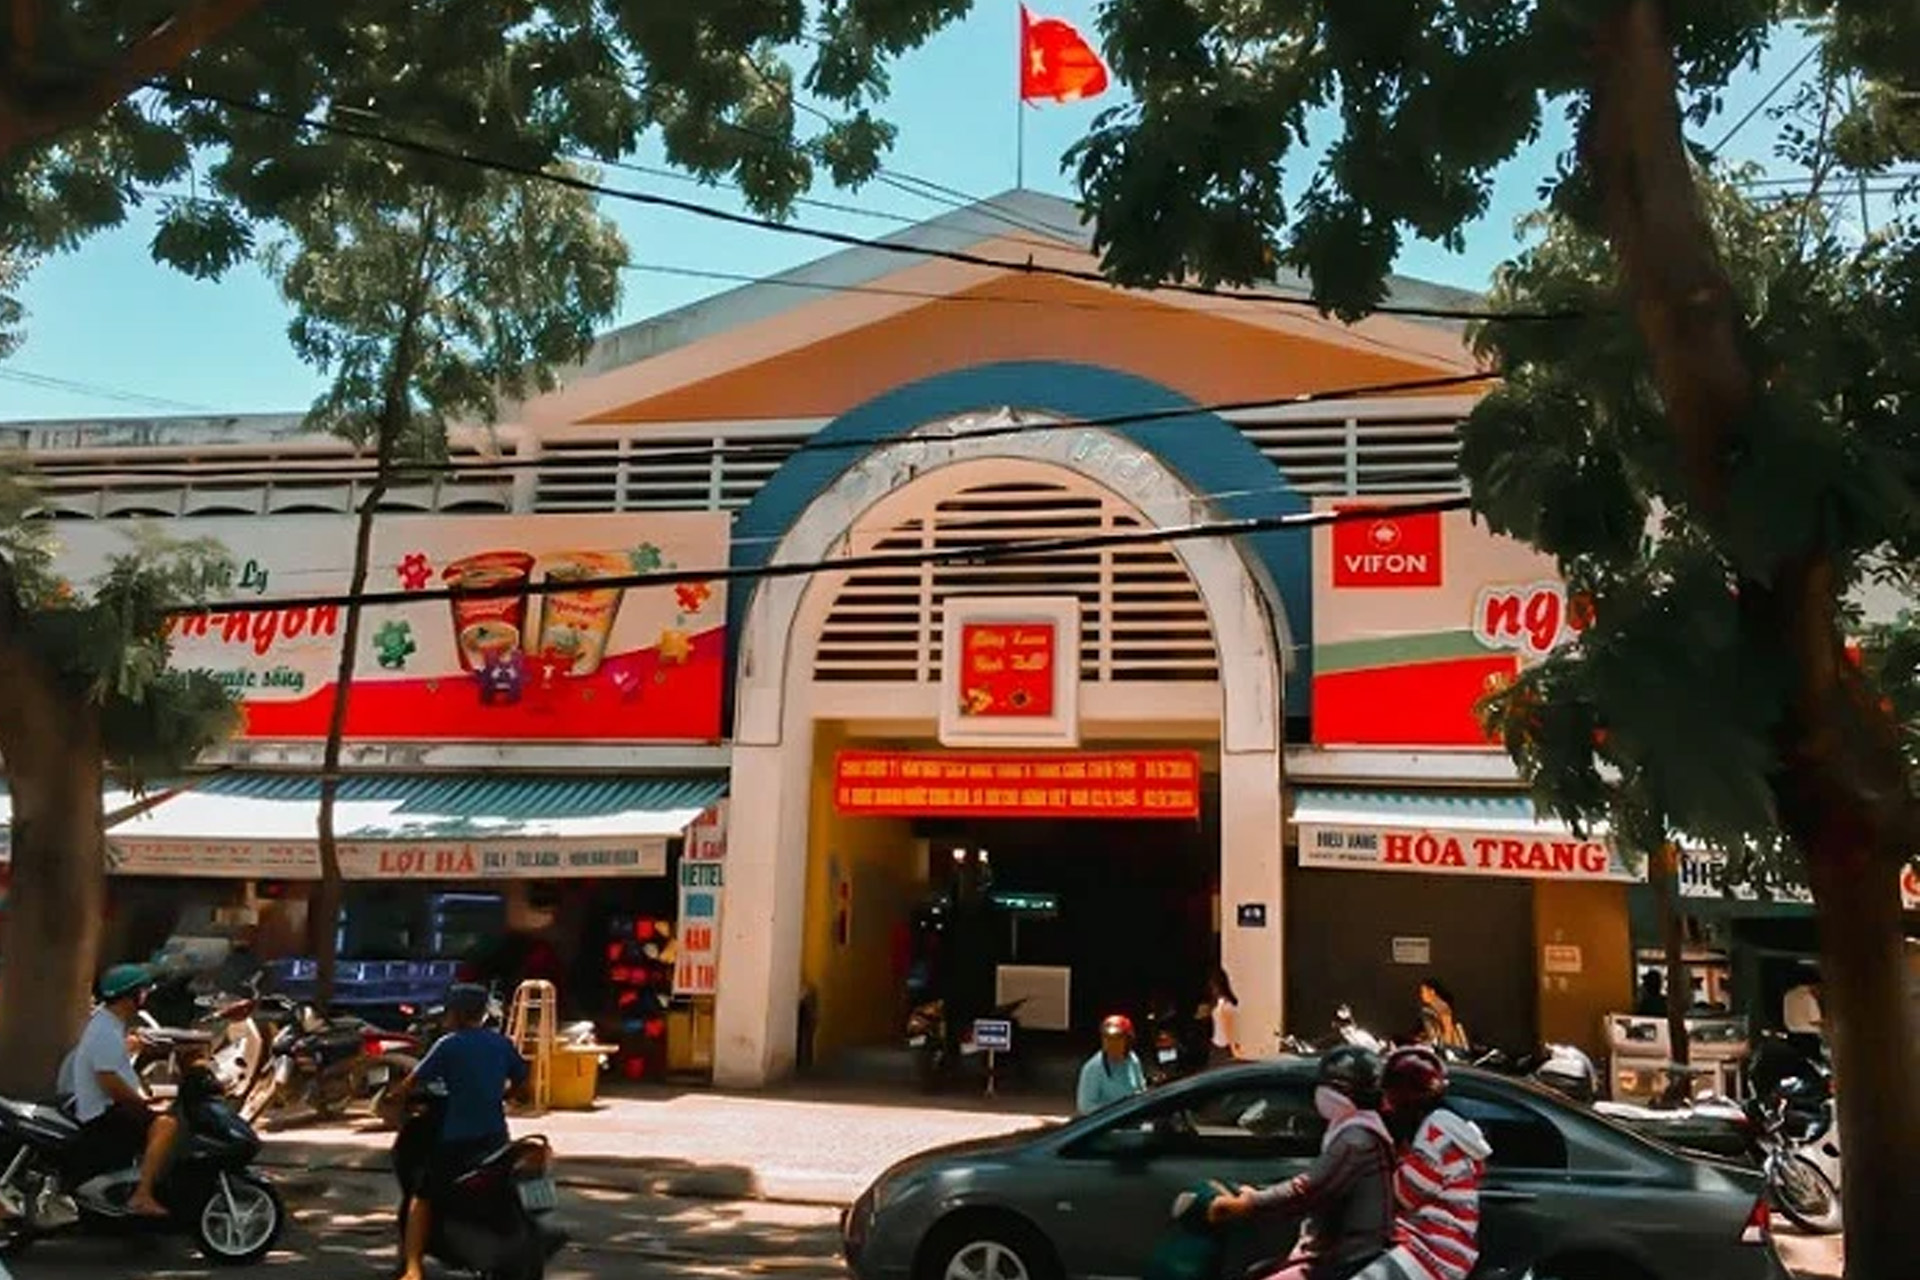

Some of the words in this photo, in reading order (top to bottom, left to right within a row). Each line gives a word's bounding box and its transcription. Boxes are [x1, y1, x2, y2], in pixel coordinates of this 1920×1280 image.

[1345, 555, 1427, 572] VIFON
[1384, 829, 1466, 866] HÒA
[1473, 838, 1607, 873] TRANG
